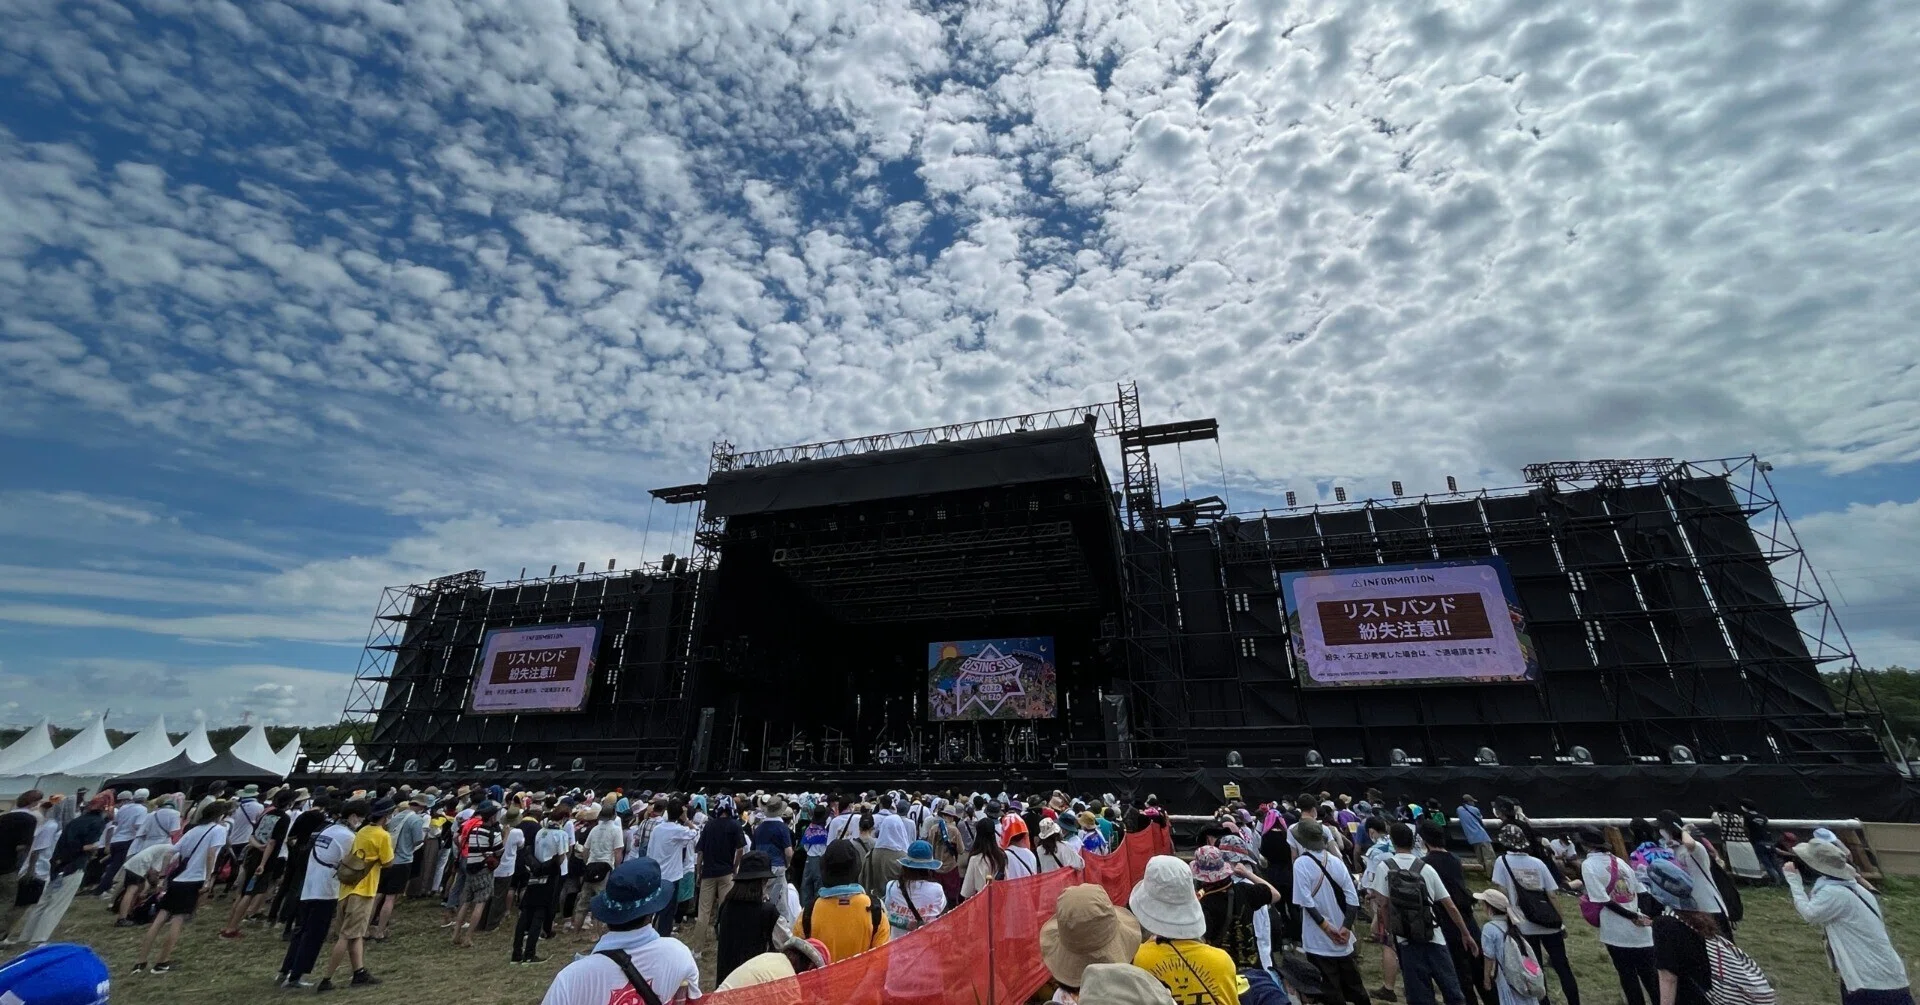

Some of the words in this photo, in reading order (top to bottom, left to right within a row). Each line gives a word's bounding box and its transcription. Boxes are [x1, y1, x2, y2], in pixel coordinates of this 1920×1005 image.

[1363, 574, 1435, 587] INFORMATION
[1344, 597, 1456, 620] リストバンド
[1358, 618, 1452, 641] 紛失注意!!
[508, 650, 567, 665] リストバンド
[961, 659, 997, 672] RISING
[996, 656, 1021, 671] SUN
[508, 666, 557, 681] 紛失注意!!
